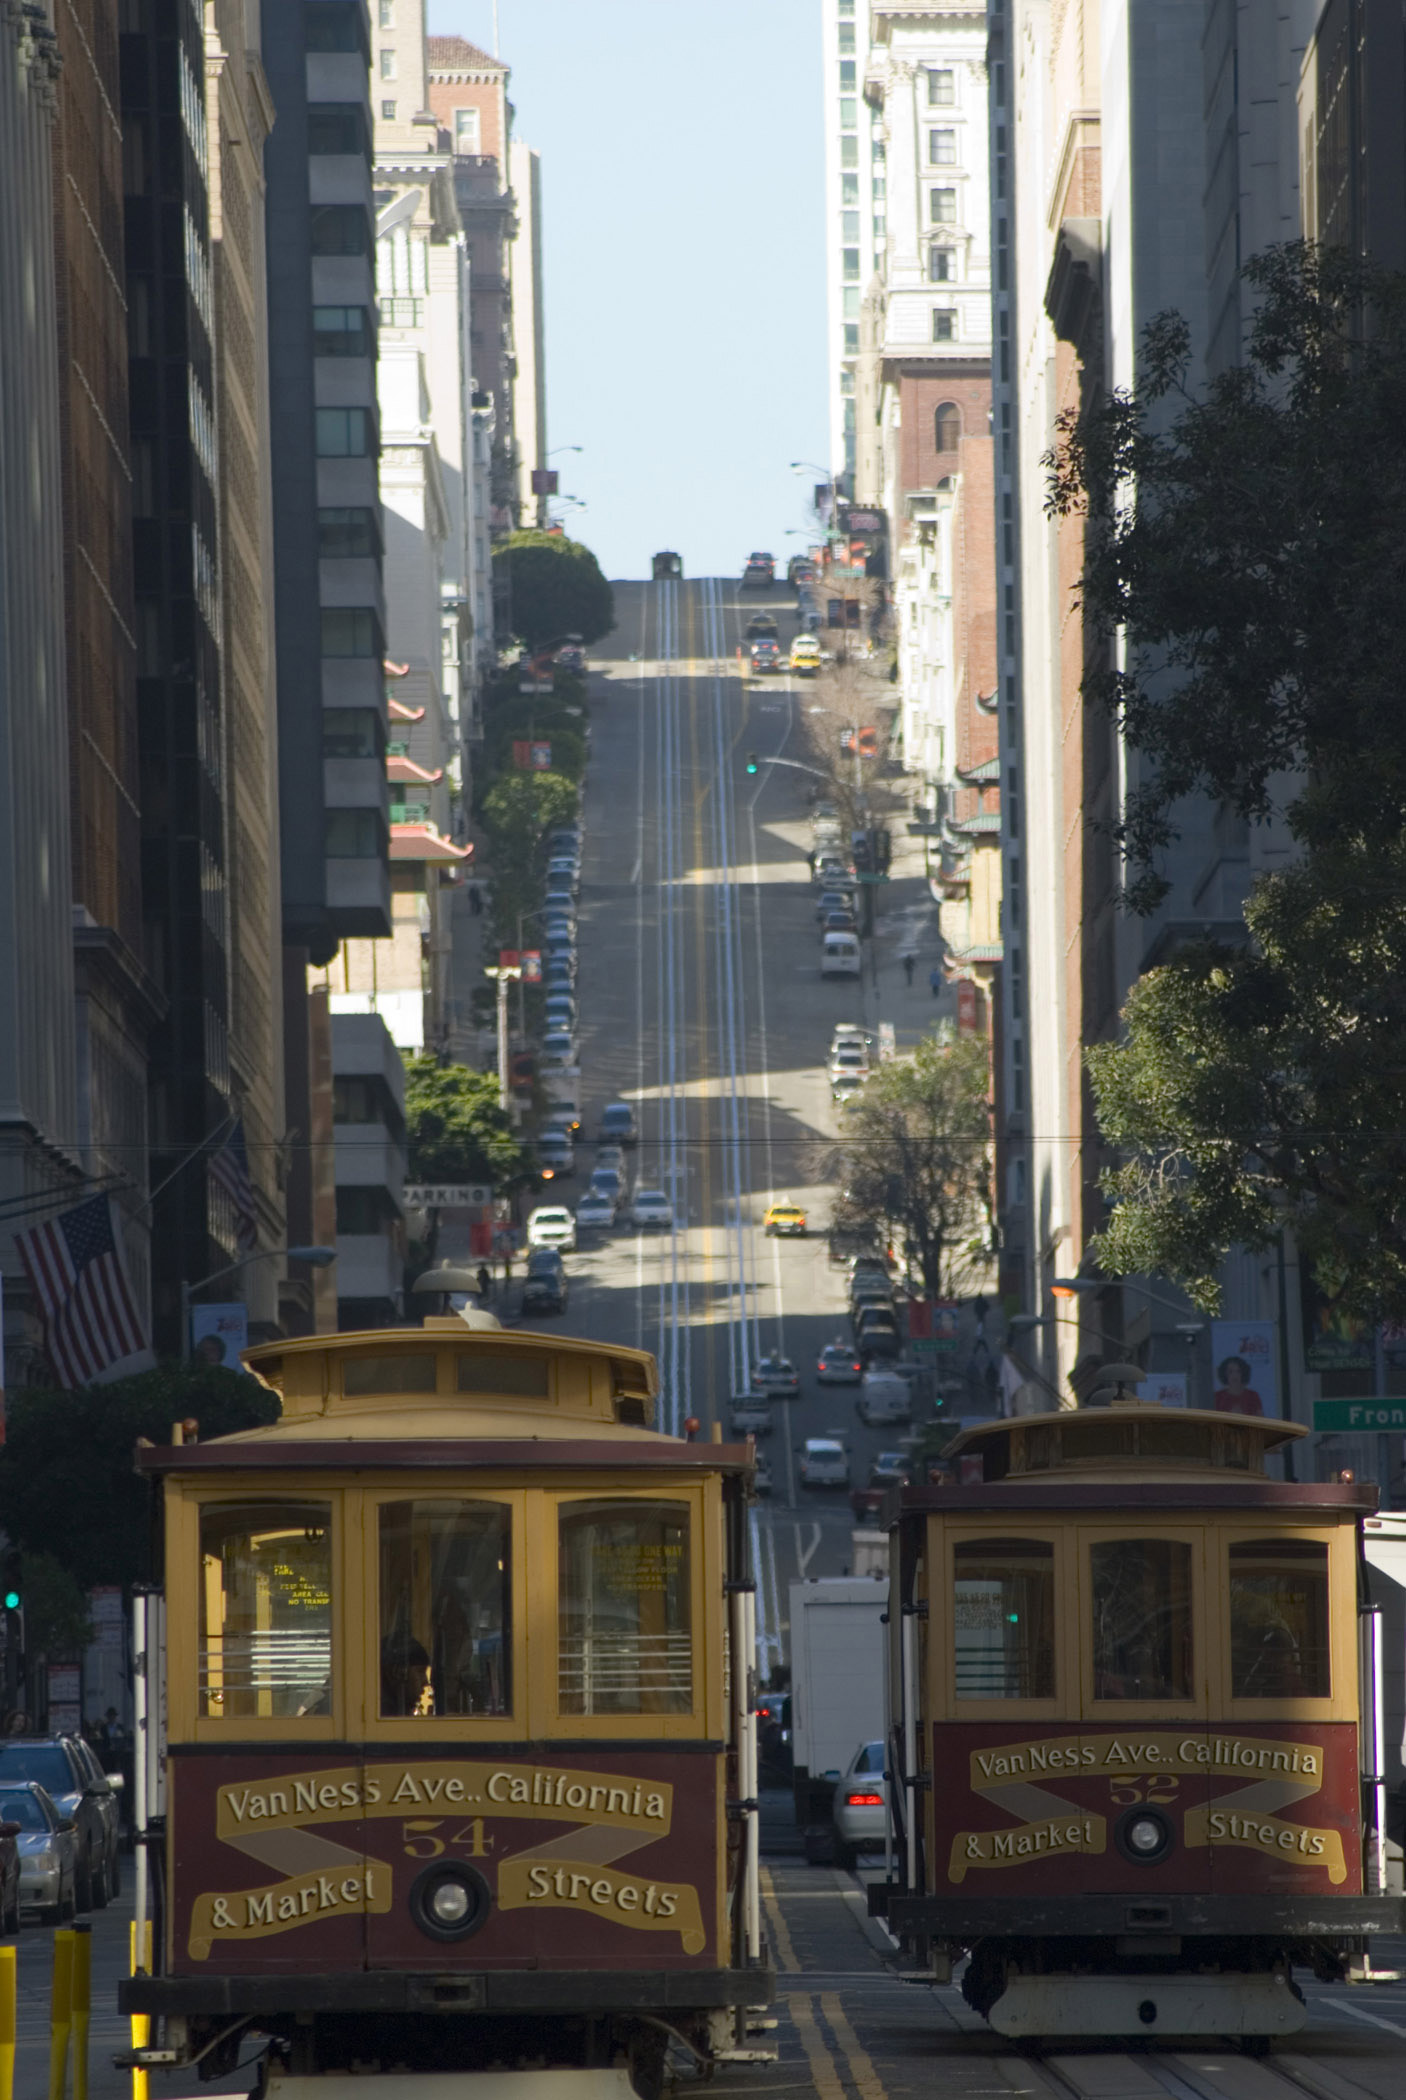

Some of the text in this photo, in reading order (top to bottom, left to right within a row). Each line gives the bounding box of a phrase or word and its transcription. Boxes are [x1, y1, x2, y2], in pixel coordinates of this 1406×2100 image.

[976, 1752, 1026, 1779] Van
[1028, 1745, 1096, 1773] Ness
[1179, 1739, 1318, 1775] California
[228, 1788, 288, 1823] Van
[292, 1779, 382, 1814] Ness
[487, 1772, 665, 1820] California
[1109, 1774, 1180, 1805] 52
[402, 1818, 495, 1859] 54
[965, 1820, 1093, 1862] & Market
[1207, 1813, 1328, 1857] Streets
[211, 1868, 376, 1929] & Market
[526, 1865, 680, 1918] Streets
